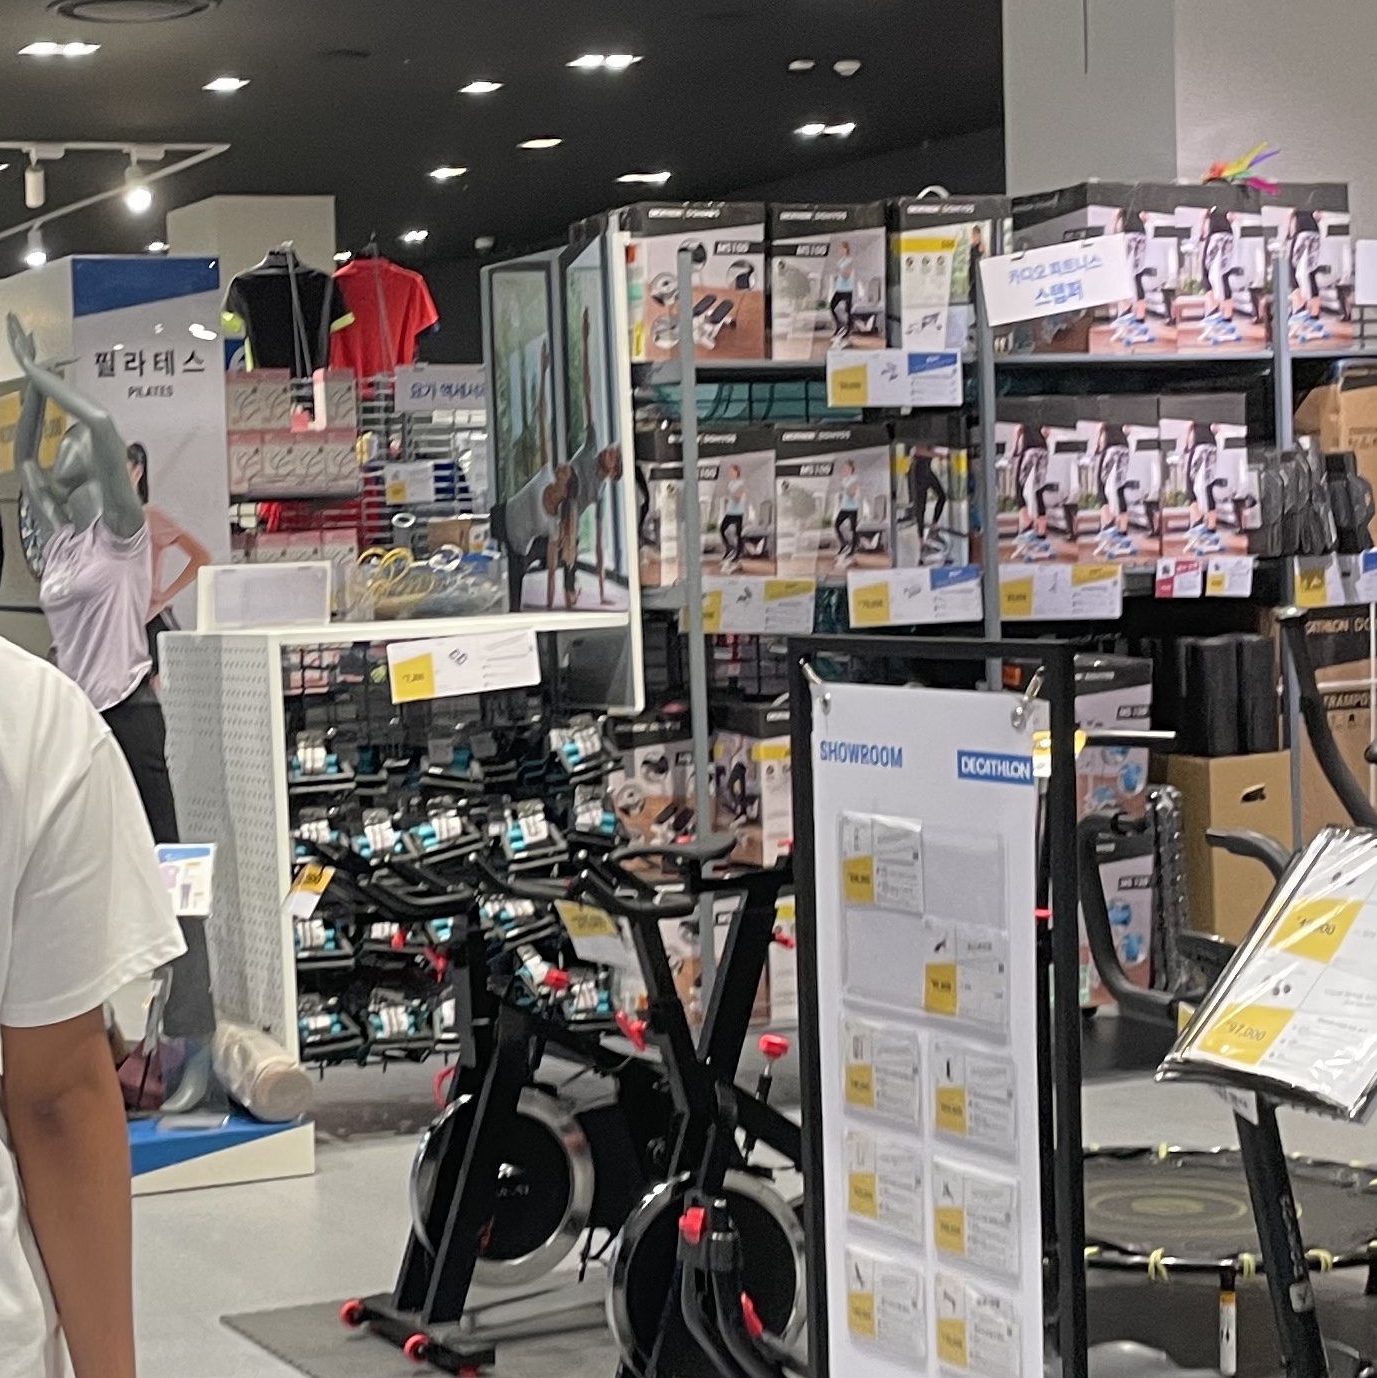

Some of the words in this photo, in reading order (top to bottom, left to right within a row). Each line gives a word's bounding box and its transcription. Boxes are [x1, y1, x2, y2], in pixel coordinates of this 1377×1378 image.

[95, 349, 205, 378] 필라테스
[128, 384, 173, 398] PILATES
[1323, 691, 1370, 709] TRAMPO
[820, 740, 903, 768] SHOWROOM
[961, 755, 1032, 780] DECATHLON
